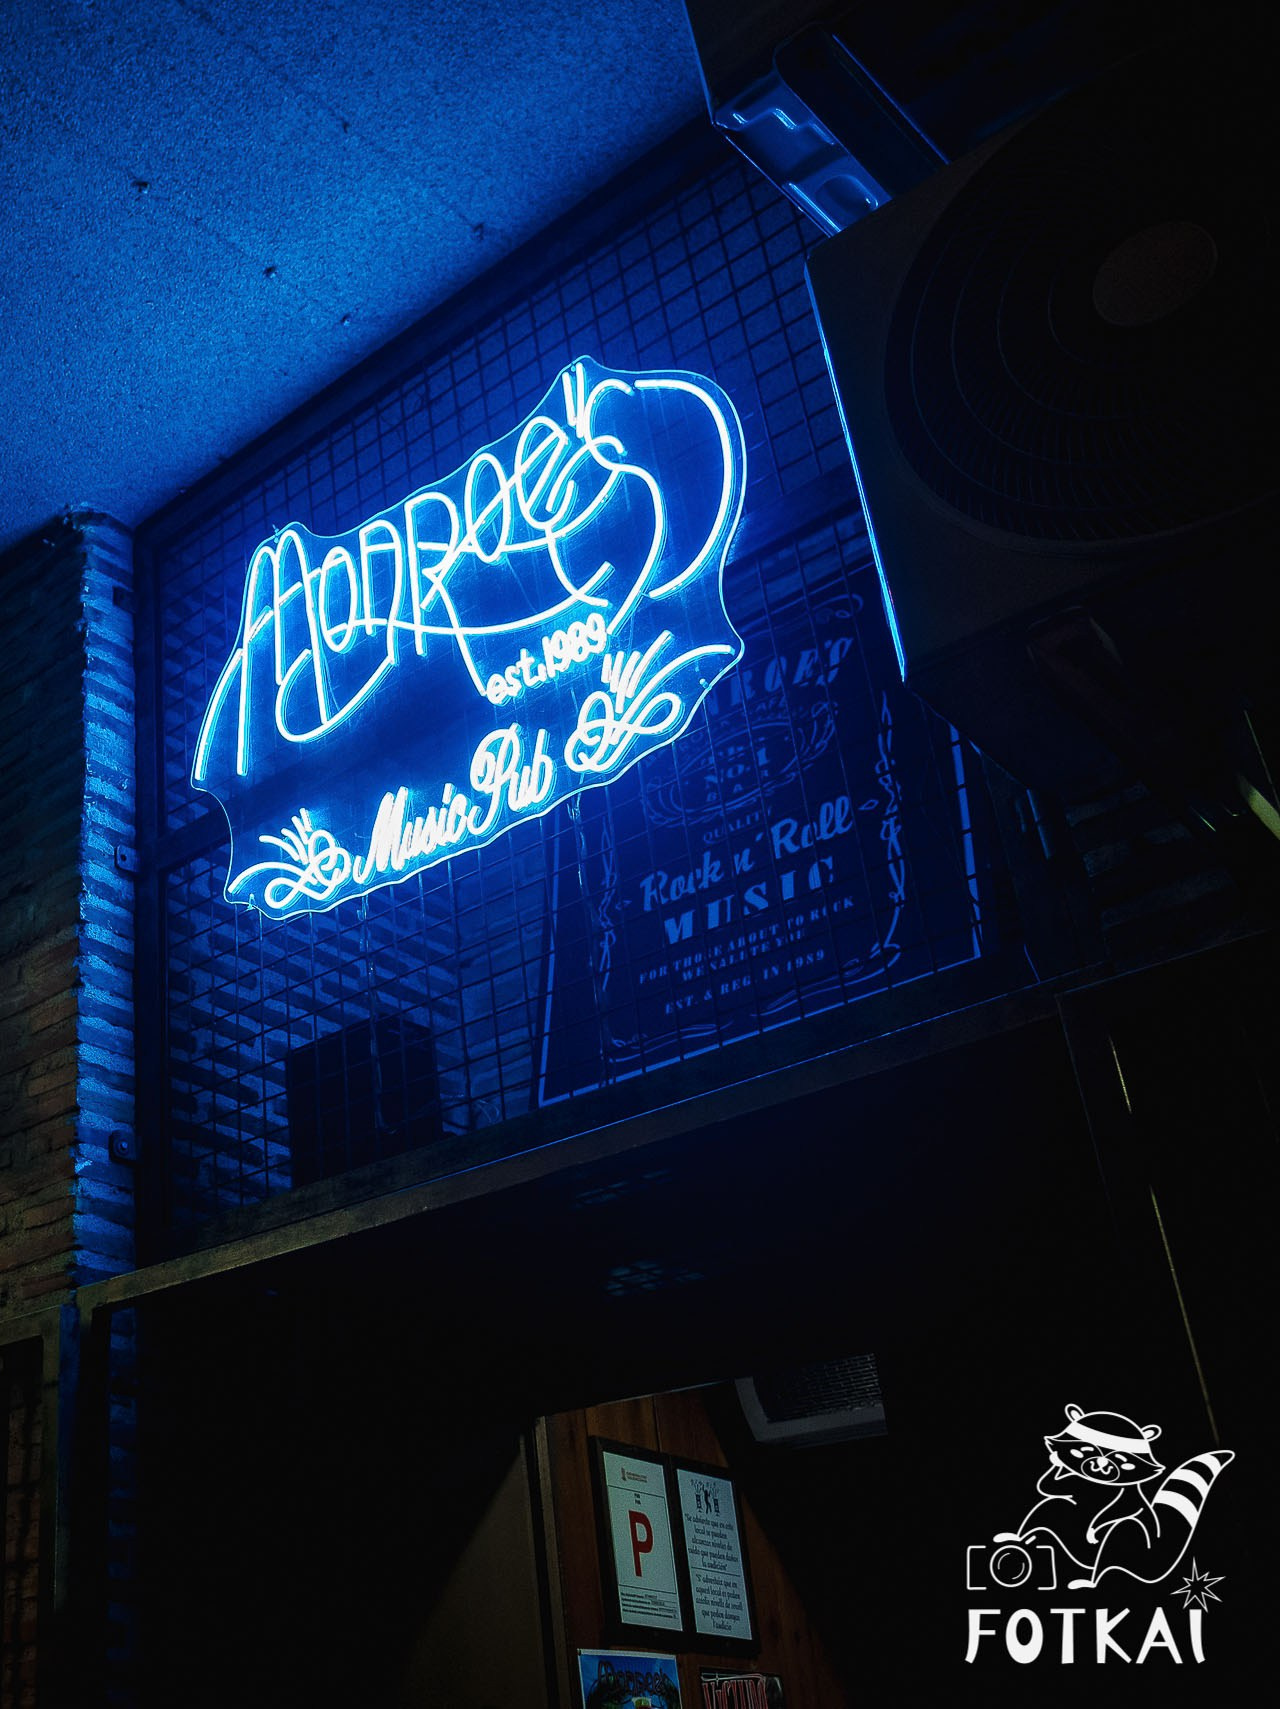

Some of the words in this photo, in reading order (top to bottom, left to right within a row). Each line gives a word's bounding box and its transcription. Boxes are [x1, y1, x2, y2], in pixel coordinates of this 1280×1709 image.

[353, 785, 473, 884] Music
[469, 723, 556, 836] Pub
[640, 852, 721, 911] Rock
[772, 796, 851, 857] Roll
[665, 858, 833, 942] MUSIC
[638, 965, 668, 985] FOR
[729, 924, 778, 951] ABOUT
[786, 948, 825, 971] 1989
[628, 1510, 654, 1577] P
